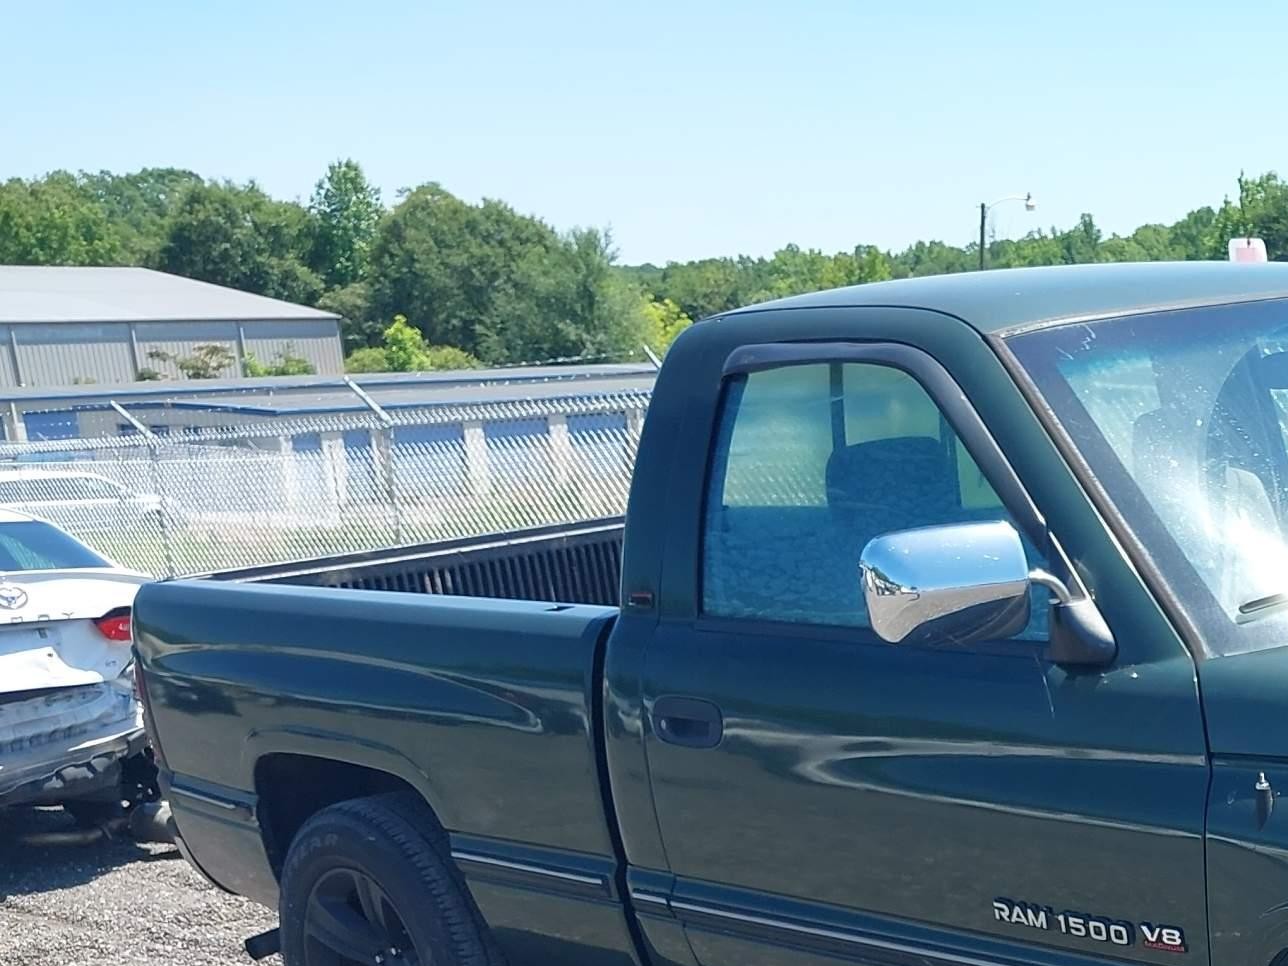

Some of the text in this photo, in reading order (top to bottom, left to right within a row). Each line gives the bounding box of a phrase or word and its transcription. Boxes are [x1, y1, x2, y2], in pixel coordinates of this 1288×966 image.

[992, 900, 1183, 946] RAM 1500 V8
